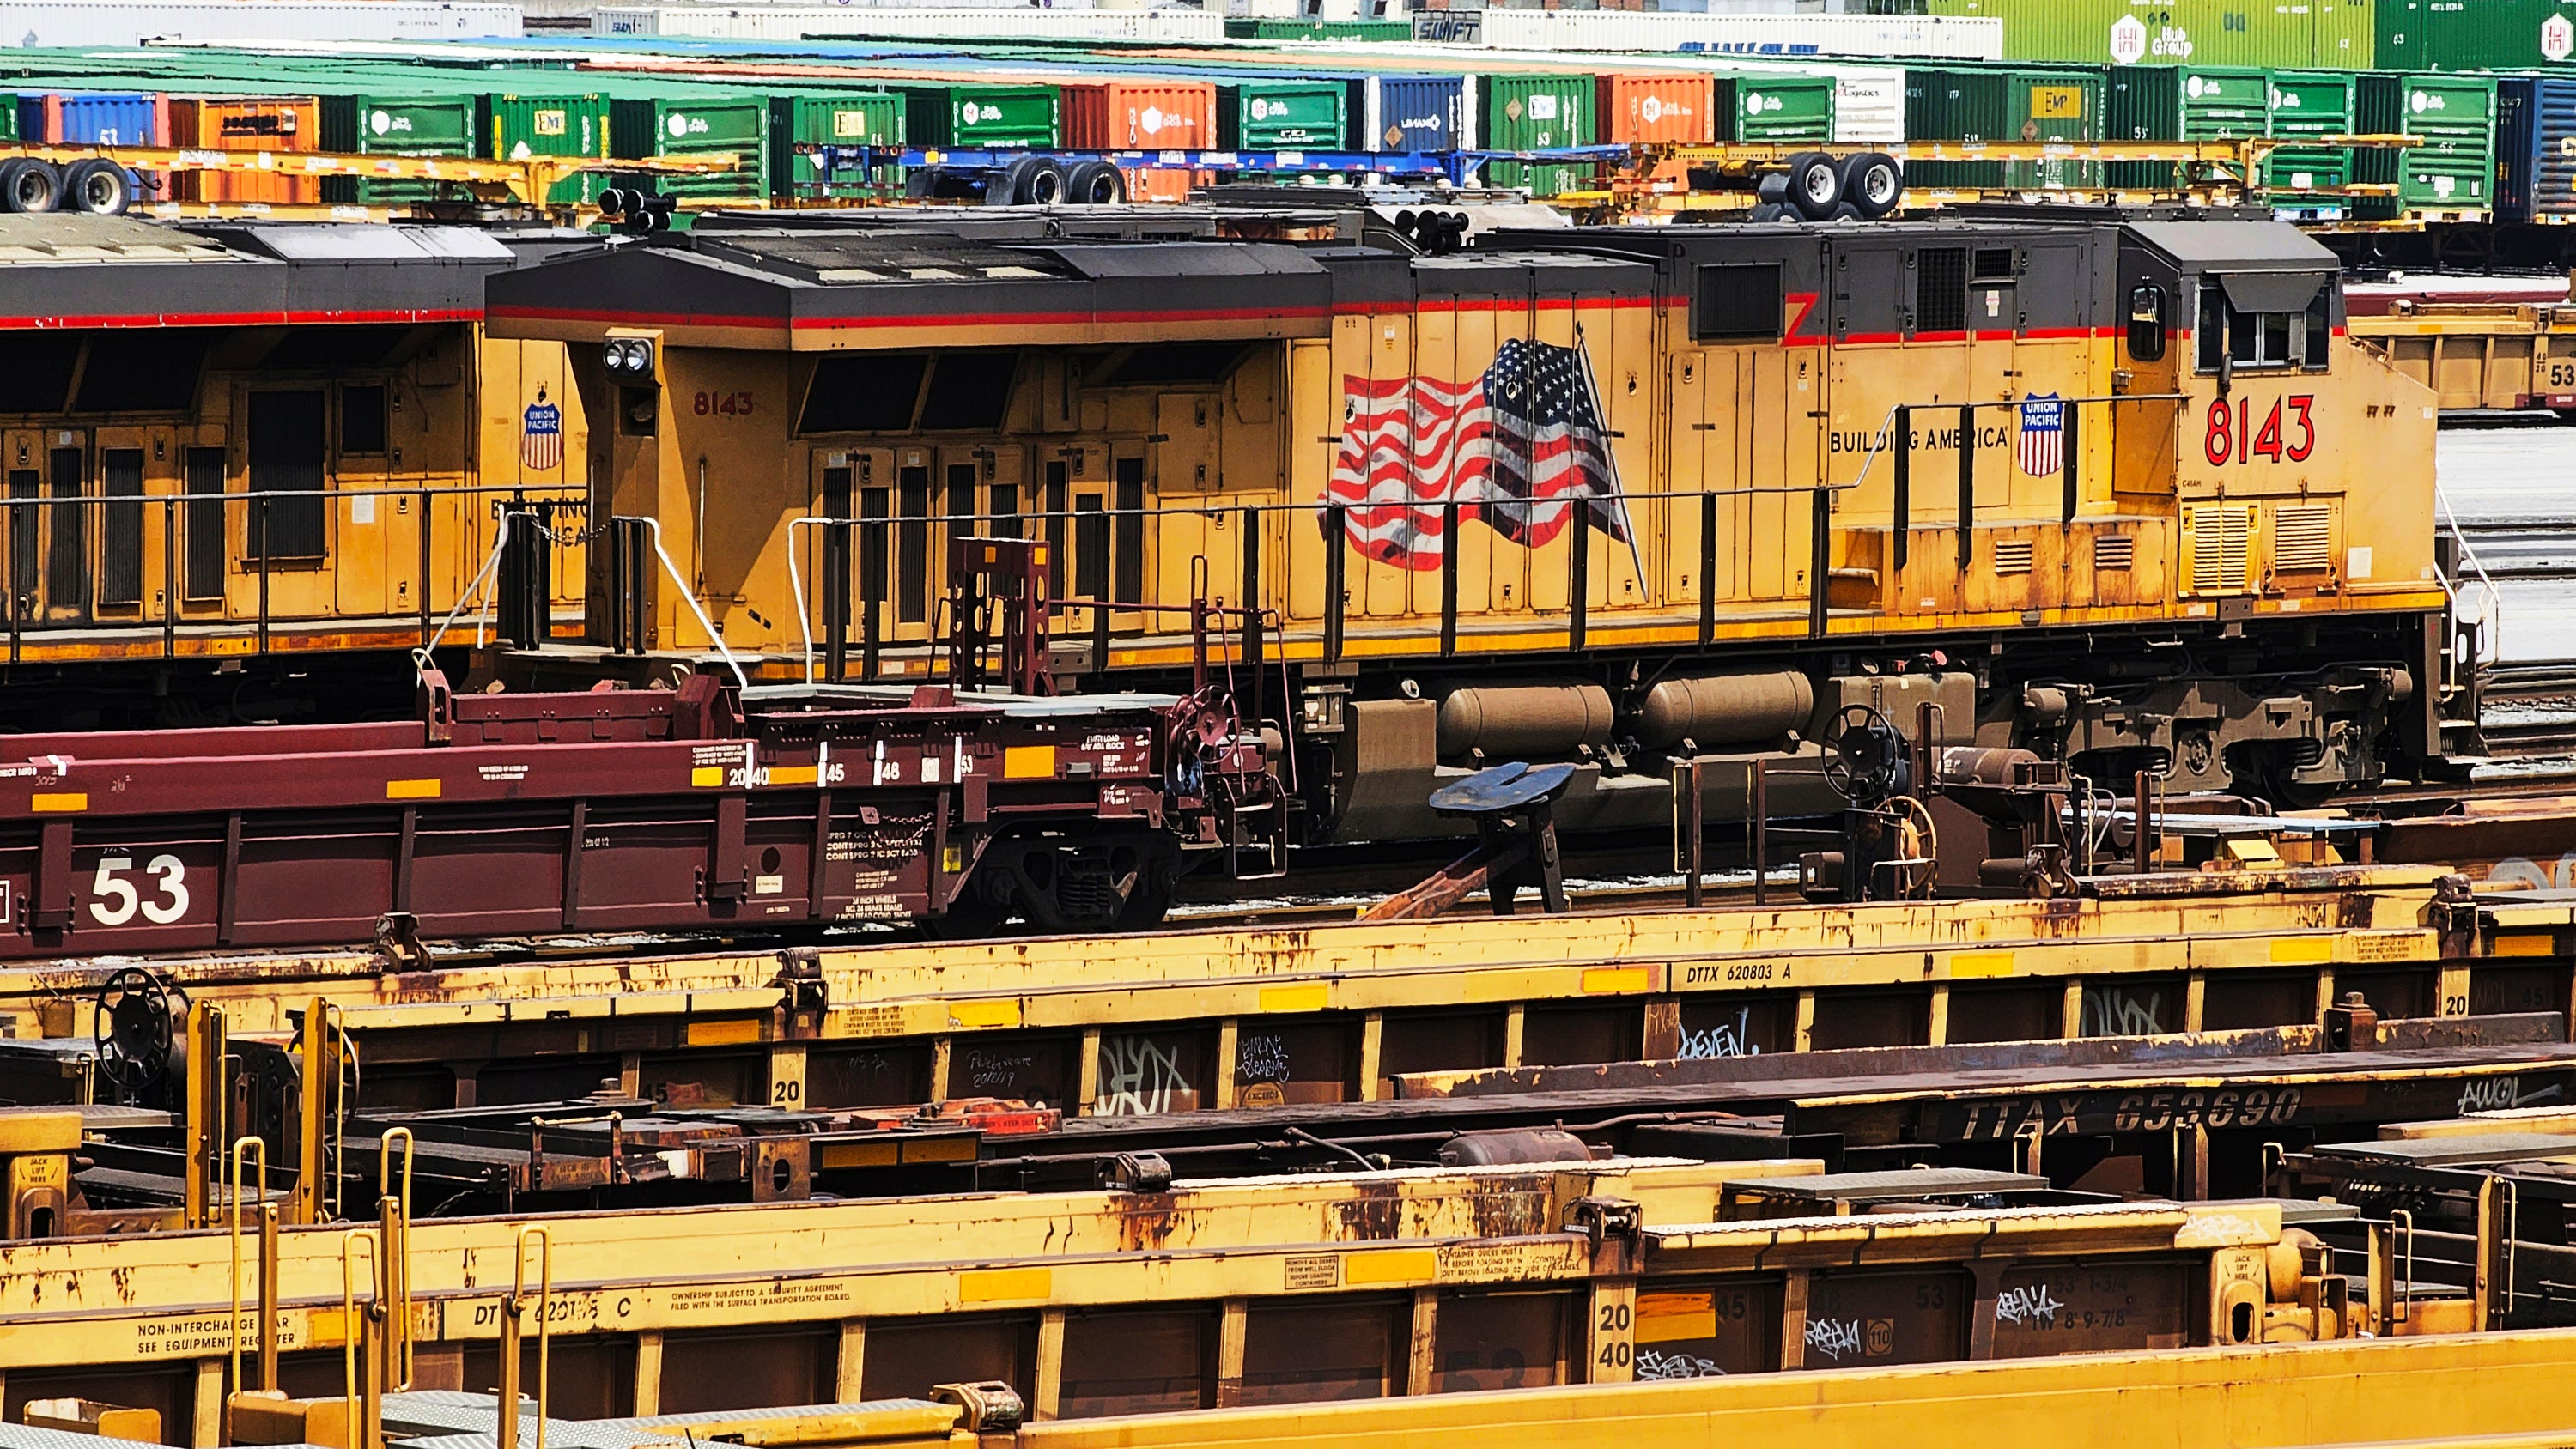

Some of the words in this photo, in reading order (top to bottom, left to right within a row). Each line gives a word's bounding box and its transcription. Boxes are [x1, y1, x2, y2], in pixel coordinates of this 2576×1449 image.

[2162, 26, 2185, 42] Hub
[2152, 39, 2193, 58] Group
[2046, 91, 2068, 112] EMP
[2550, 364, 2575, 387] 53
[693, 391, 754, 416] 8143
[2026, 402, 2058, 414] UNION
[527, 419, 557, 430] PACIFIC
[529, 409, 555, 421] UNION
[2024, 414, 2060, 427] PACIFIC
[1830, 430, 1919, 453] BUILDIG
[1925, 427, 2008, 451] AMEICA
[2204, 393, 2315, 467] 8143
[827, 763, 845, 782] 45
[882, 761, 901, 781] 48
[961, 755, 973, 773] 53
[729, 768, 746, 786] 20
[751, 767, 770, 785] 40
[826, 852, 848, 861] CONT
[89, 854, 189, 925] 53
[1686, 966, 1720, 983] DTTX
[1728, 964, 1772, 981] 620803
[1783, 963, 1792, 979] A
[2446, 996, 2466, 1016] 20
[774, 1080, 799, 1103] 20
[1248, 1091, 1279, 1100] EXCEEDS
[2458, 1076, 2562, 1114] AWOL
[1962, 1097, 2084, 1140] TTAX
[671, 1291, 712, 1300] OWNERSHIP
[715, 1289, 744, 1299] SUBJECT
[769, 1286, 801, 1295] SURITY
[804, 1283, 843, 1293] AGREEMENT
[1916, 1284, 1943, 1309] 53
[475, 1306, 497, 1325] DT
[617, 1297, 631, 1318] C
[671, 1301, 689, 1311] FILED
[692, 1300, 710, 1309] WITH
[713, 1300, 724, 1308] THE
[727, 1297, 756, 1307] SURFACE
[760, 1294, 821, 1306] TRANSPORTATION
[824, 1293, 850, 1301] BOARD.
[1600, 1303, 1630, 1331] 20
[138, 1319, 254, 1337] NON-INTERCHAGE
[1869, 1328, 1890, 1348] 110
[138, 1341, 156, 1354] SEE
[166, 1337, 232, 1352] EQUIPMENT
[240, 1333, 295, 1347] REGTER
[1599, 1341, 1630, 1367] 40
